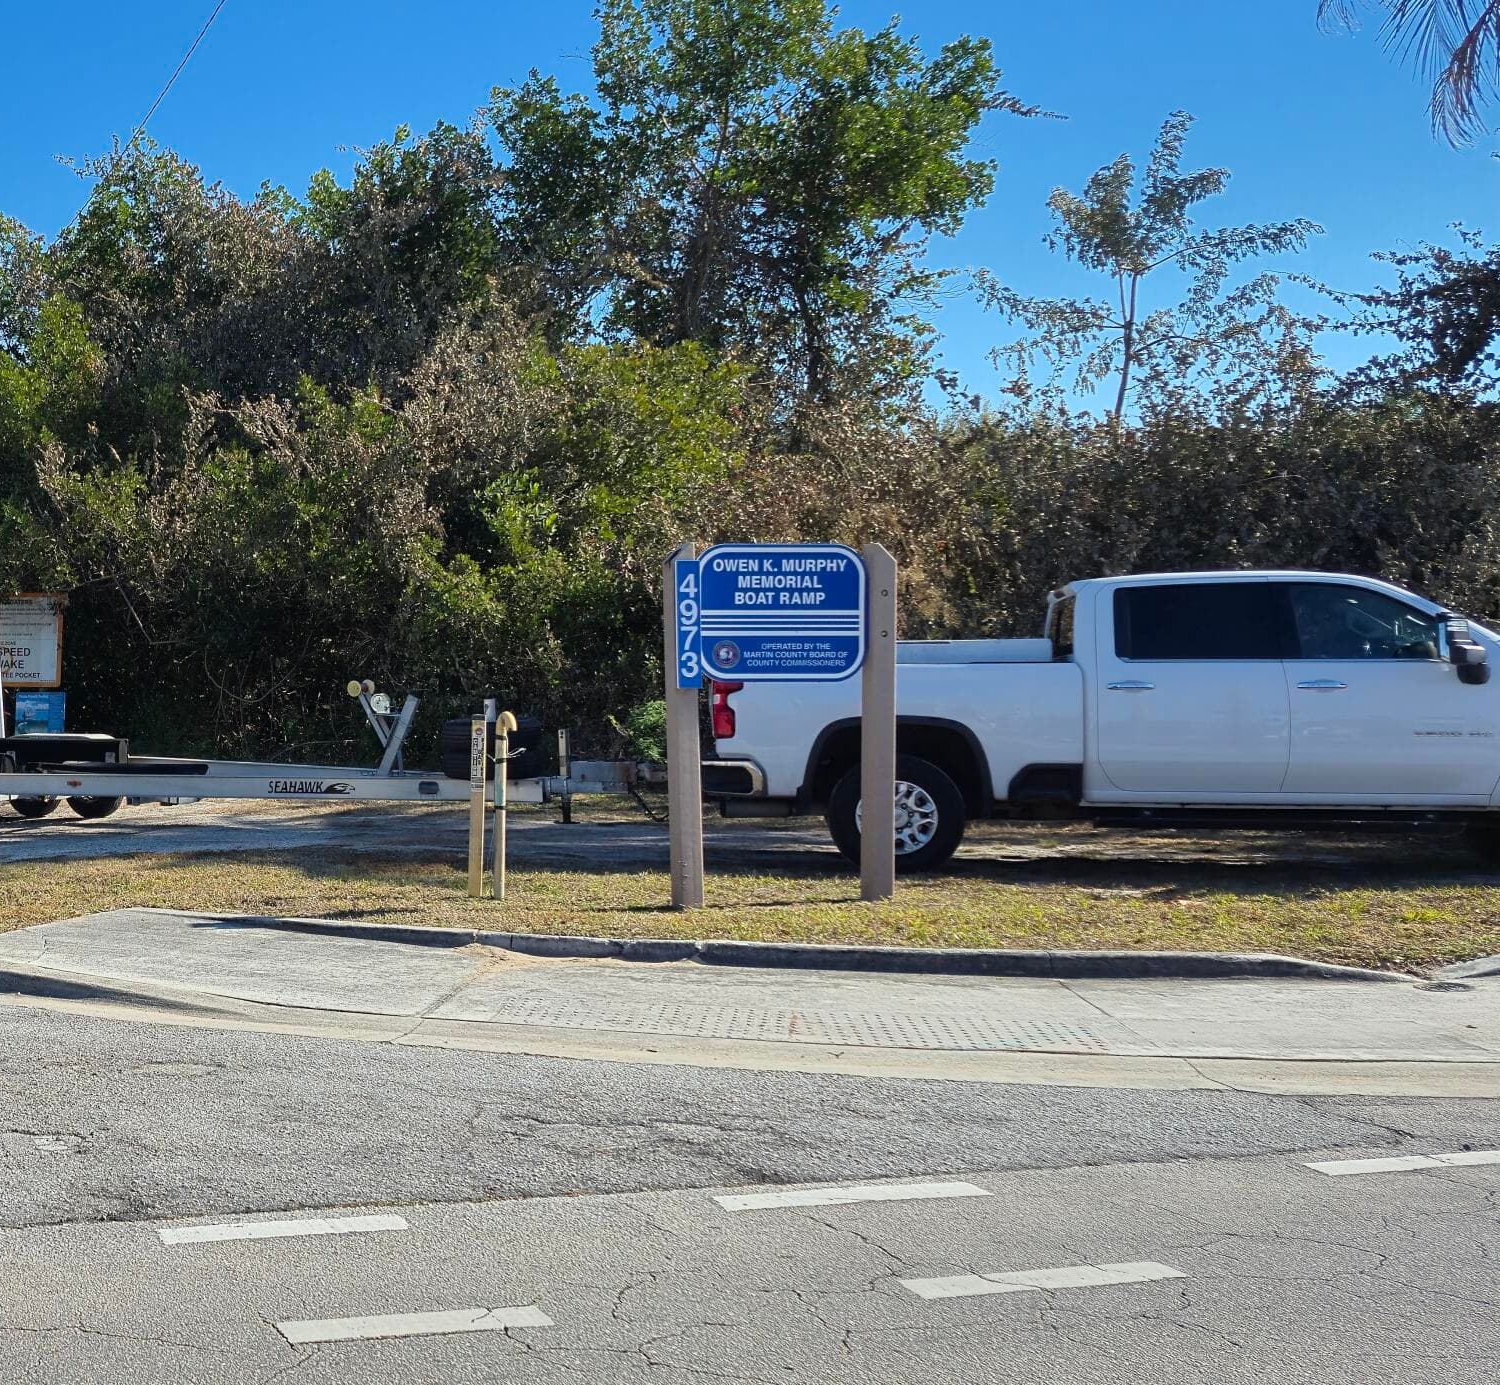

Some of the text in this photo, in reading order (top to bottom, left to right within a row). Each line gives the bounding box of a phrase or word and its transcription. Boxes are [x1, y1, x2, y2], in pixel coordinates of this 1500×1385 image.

[712, 559, 848, 572] OWEN K. MURPHY
[737, 575, 823, 588] MEMORIAL
[734, 592, 826, 605] BOAT RAMP
[679, 573, 699, 678] 4973
[746, 659, 846, 667] COUNTY COMMISSIONERS
[14, 671, 41, 679] POCKET
[267, 780, 324, 794] SEAHAWK
